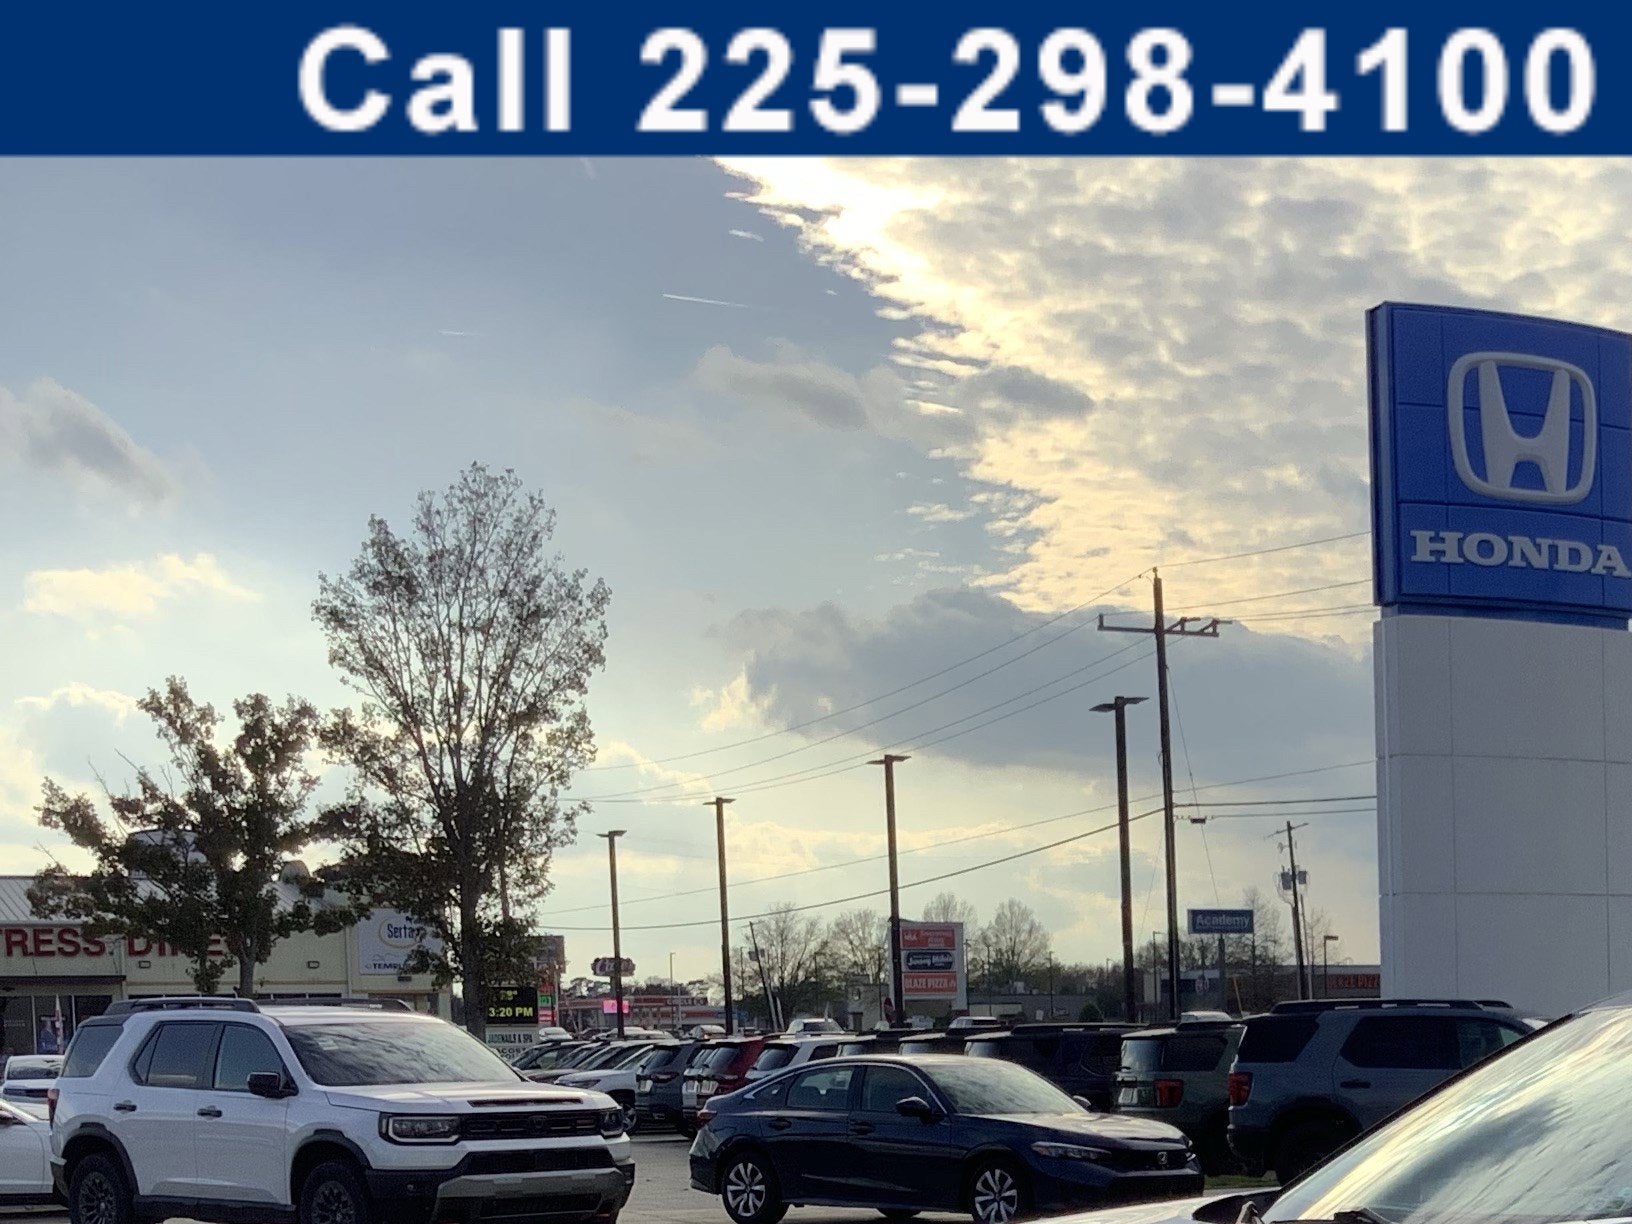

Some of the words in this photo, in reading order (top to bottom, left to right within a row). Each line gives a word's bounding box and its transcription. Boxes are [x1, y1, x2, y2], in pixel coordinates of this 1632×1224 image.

[1410, 529, 1632, 578] HONDA
[1195, 913, 1250, 929] Academy
[387, 923, 415, 939] Serta
[488, 1007, 512, 1017] 3:20
[515, 1007, 534, 1017] PM
